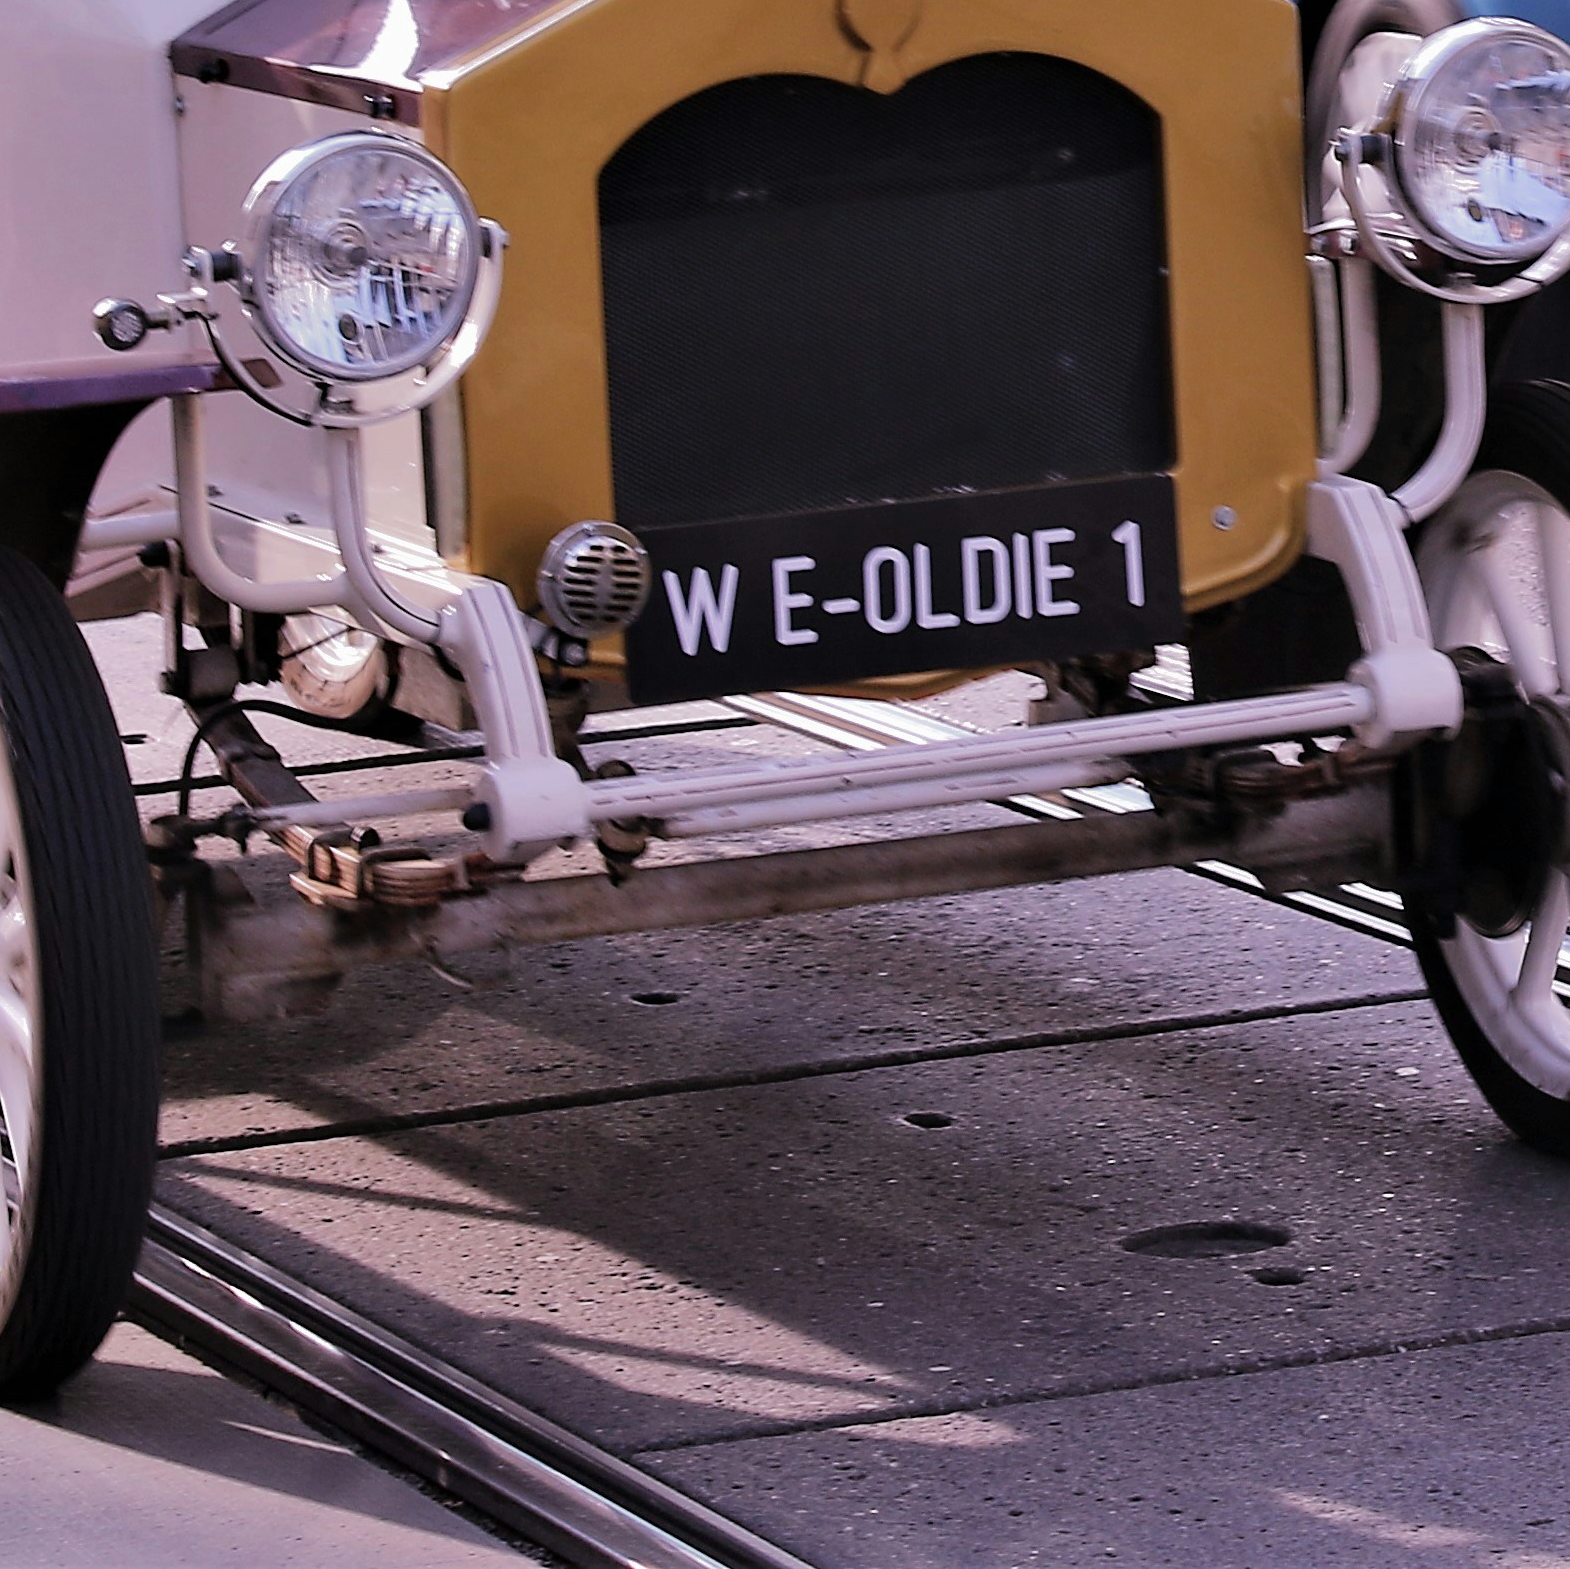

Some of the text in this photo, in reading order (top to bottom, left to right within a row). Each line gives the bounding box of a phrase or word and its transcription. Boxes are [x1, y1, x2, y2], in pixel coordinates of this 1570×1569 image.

[662, 520, 1146, 657] W E-OLDIE 1
